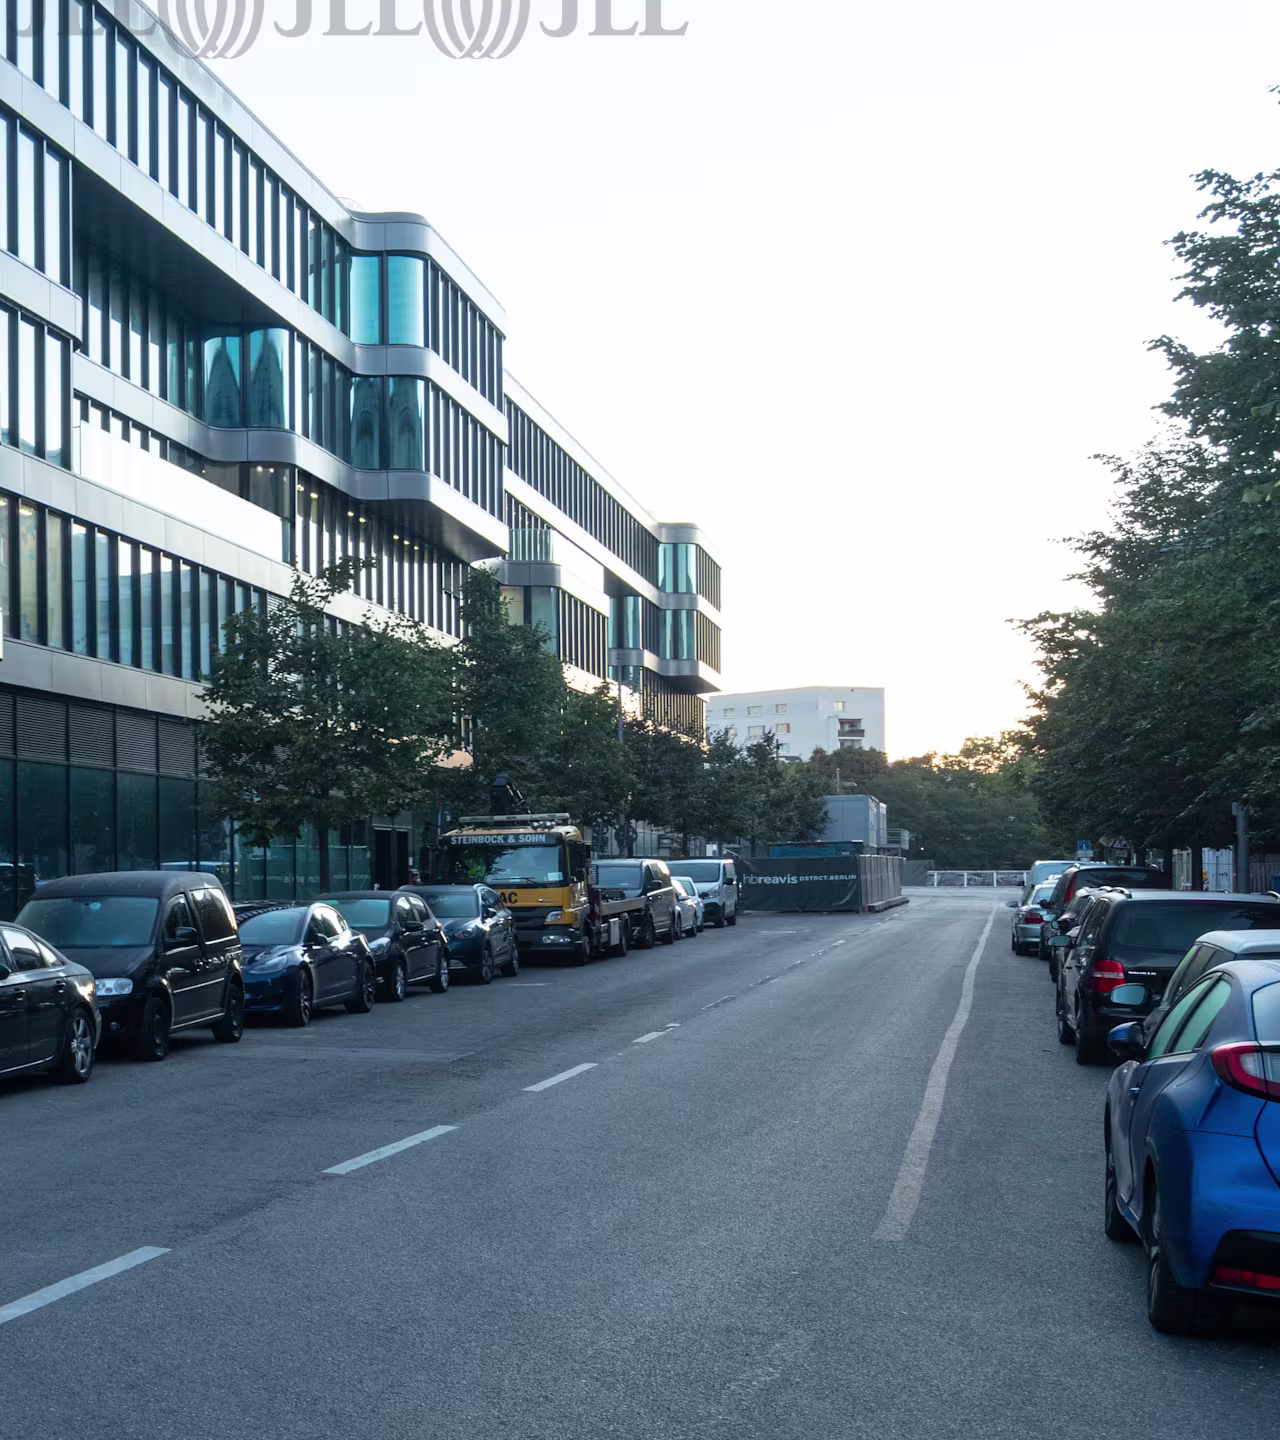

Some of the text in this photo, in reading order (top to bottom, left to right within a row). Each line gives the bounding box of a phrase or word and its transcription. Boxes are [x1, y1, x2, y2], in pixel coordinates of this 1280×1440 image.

[450, 834, 546, 845] STEINBOCK & SOHN
